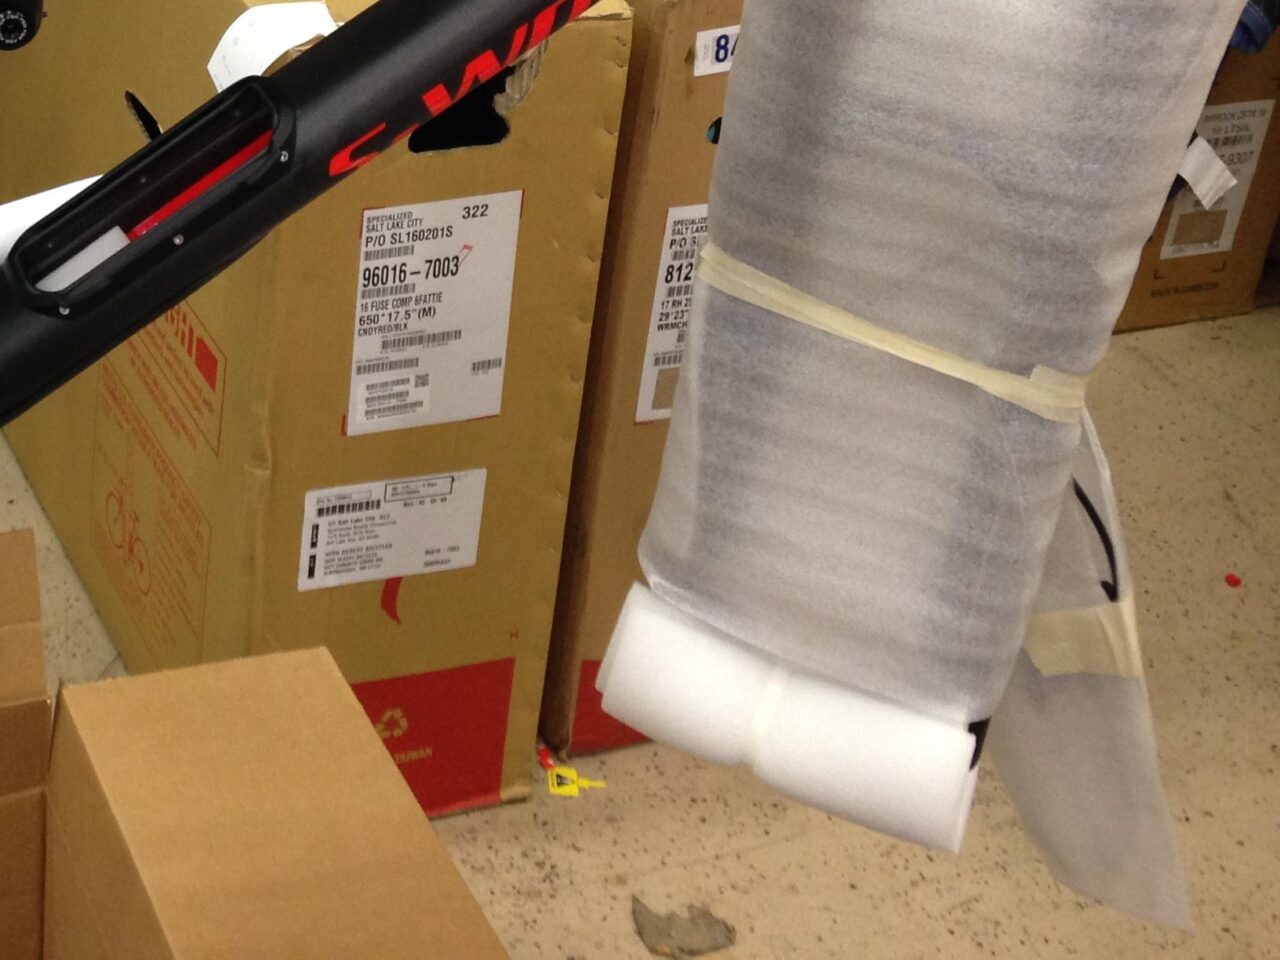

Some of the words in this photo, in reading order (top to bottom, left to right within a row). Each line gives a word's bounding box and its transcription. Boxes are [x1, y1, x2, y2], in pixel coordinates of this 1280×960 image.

[366, 211, 413, 224] SPECIALIZED
[462, 203, 489, 220] 322
[365, 222, 384, 234] SALT
[386, 220, 404, 231] LAKE
[407, 218, 424, 229] CITY
[673, 217, 708, 228] SPECIALIZE
[365, 234, 386, 249] P/O
[390, 225, 454, 245] SL160201S
[671, 226, 689, 237] SALT
[664, 262, 694, 284] 812
[360, 302, 369, 313] 16
[370, 300, 389, 312] FUSE
[391, 296, 413, 309] COMP
[660, 299, 670, 310] 17
[671, 298, 682, 308] RH
